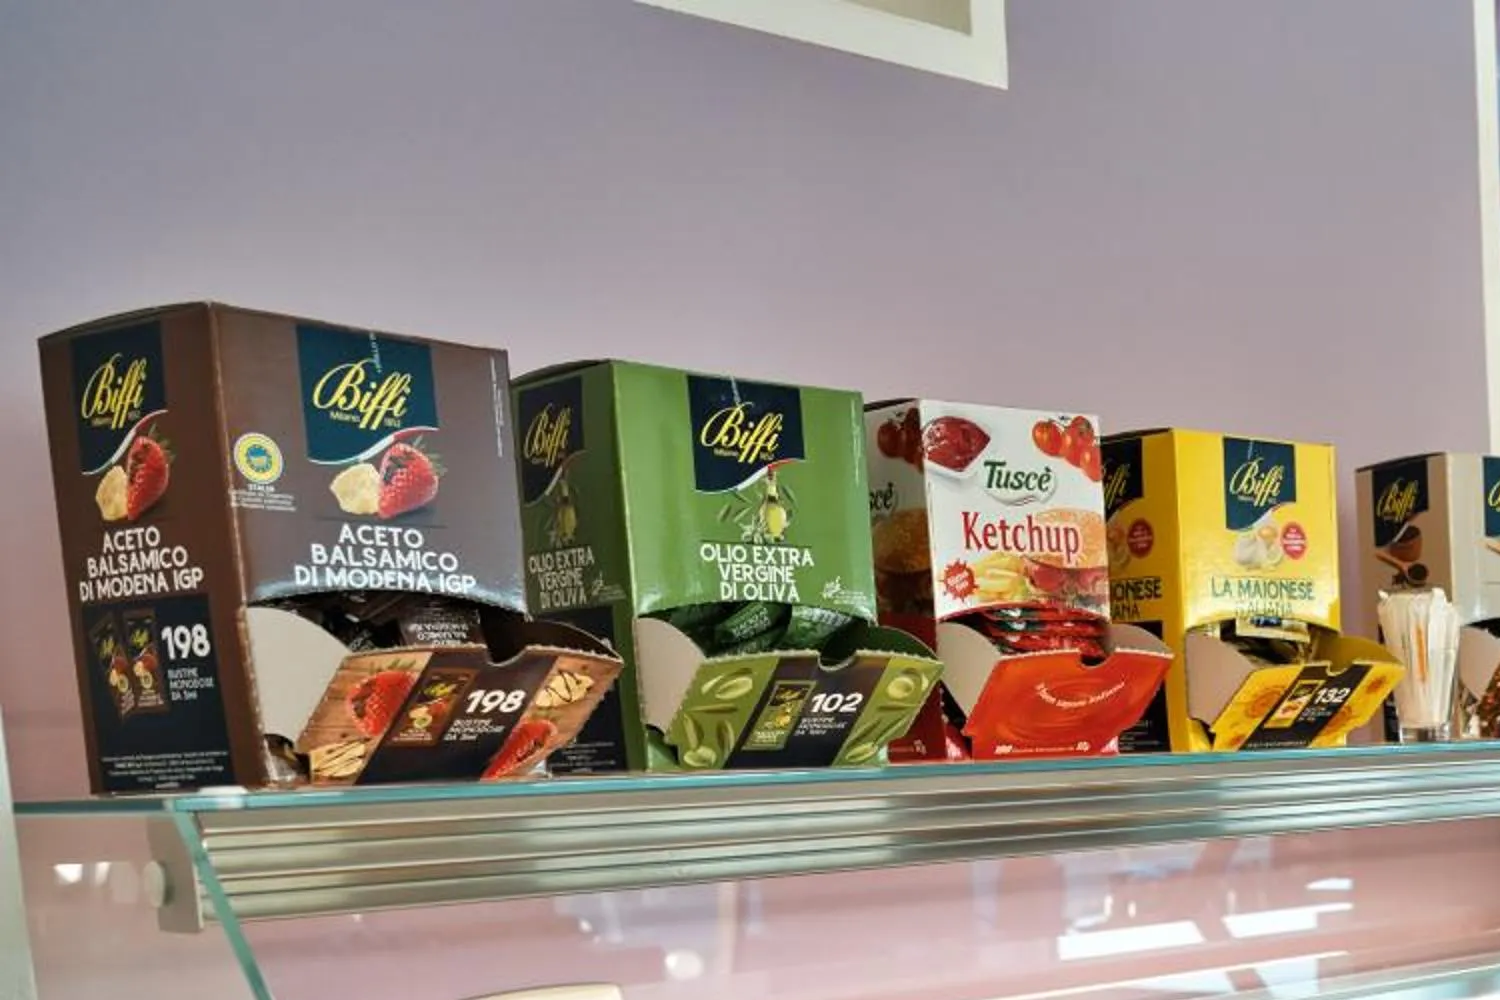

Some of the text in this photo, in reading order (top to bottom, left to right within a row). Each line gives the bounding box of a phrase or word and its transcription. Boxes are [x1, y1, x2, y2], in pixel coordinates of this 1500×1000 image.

[81, 353, 148, 430] Biffi
[312, 357, 413, 430] Biffi
[524, 403, 572, 468] Biffi
[701, 401, 783, 464] Biffi
[983, 460, 1053, 493] Tuscè
[1229, 457, 1286, 507] Biffi
[1376, 476, 1419, 523] Biffi
[102, 527, 160, 553] ACETO
[339, 523, 424, 548] ACETO
[961, 511, 1080, 563] Ketchup
[87, 547, 188, 578] BALSAMICO
[311, 543, 458, 571] BALSAMICO
[528, 546, 594, 574] OLIO EXTRA
[700, 543, 814, 567] OLIO EXTRA
[79, 567, 204, 601] DI MODENA IGP
[294, 565, 477, 594] DI MODENA IGP
[537, 567, 582, 589] VERGINE
[718, 563, 796, 583] VERGINE
[554, 585, 587, 607] OLIVA
[720, 582, 737, 600] DI
[743, 584, 800, 602] OLIVA
[1211, 576, 1315, 600] LA MAIONESE
[161, 623, 211, 660] 198
[466, 689, 526, 713] 198
[811, 692, 863, 713] 102
[1314, 687, 1350, 704] 132
